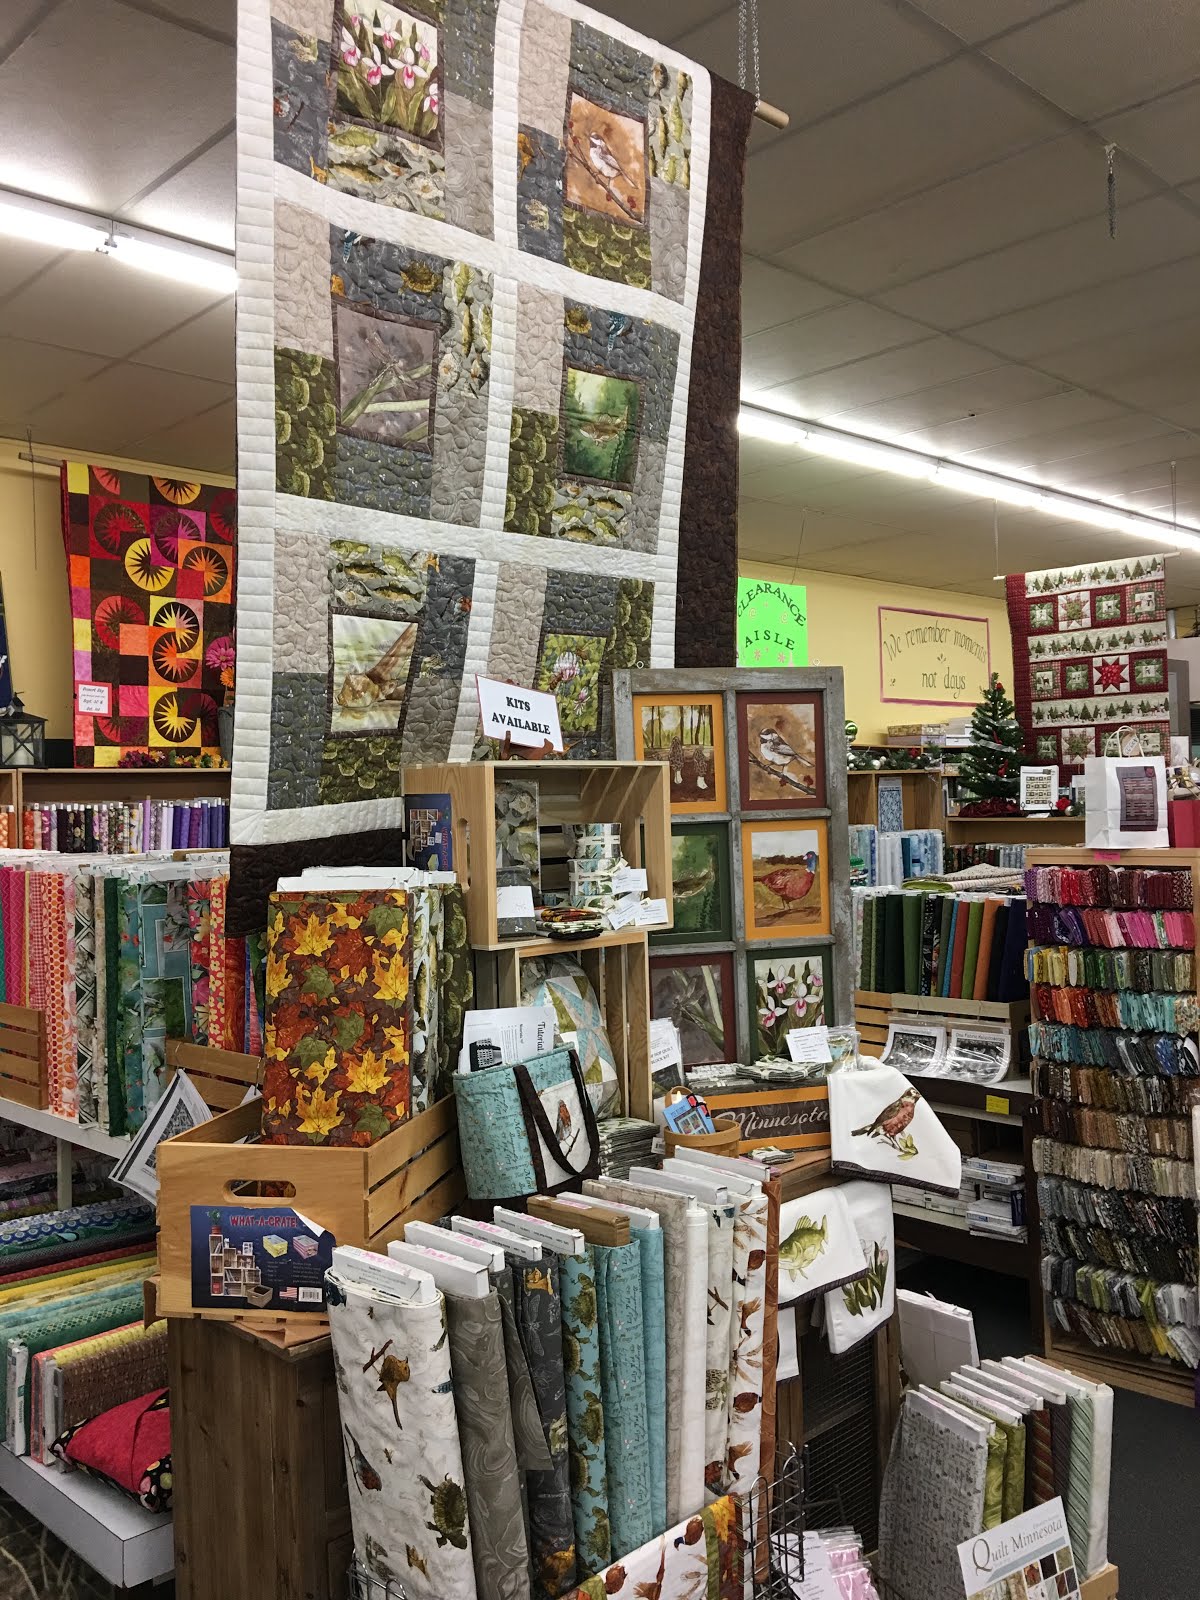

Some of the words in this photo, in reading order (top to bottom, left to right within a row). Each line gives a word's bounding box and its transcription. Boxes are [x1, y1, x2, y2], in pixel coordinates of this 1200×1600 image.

[738, 583, 806, 627] CLEARANCE
[745, 629, 795, 650] AISLE
[883, 634, 901, 661] We
[905, 620, 951, 648] remember
[953, 630, 986, 663] moments
[922, 672, 937, 688] not
[943, 667, 966, 699] days
[506, 696, 531, 711] KITS
[491, 712, 551, 735] AVAILABLE
[536, 1021, 546, 1051] Tutorial
[715, 1106, 829, 1138] Minnesota
[229, 1215, 299, 1228] WHAT-A-CRATE!
[972, 1538, 1010, 1576] Quilt
[1011, 1520, 1063, 1552] Minnesota
